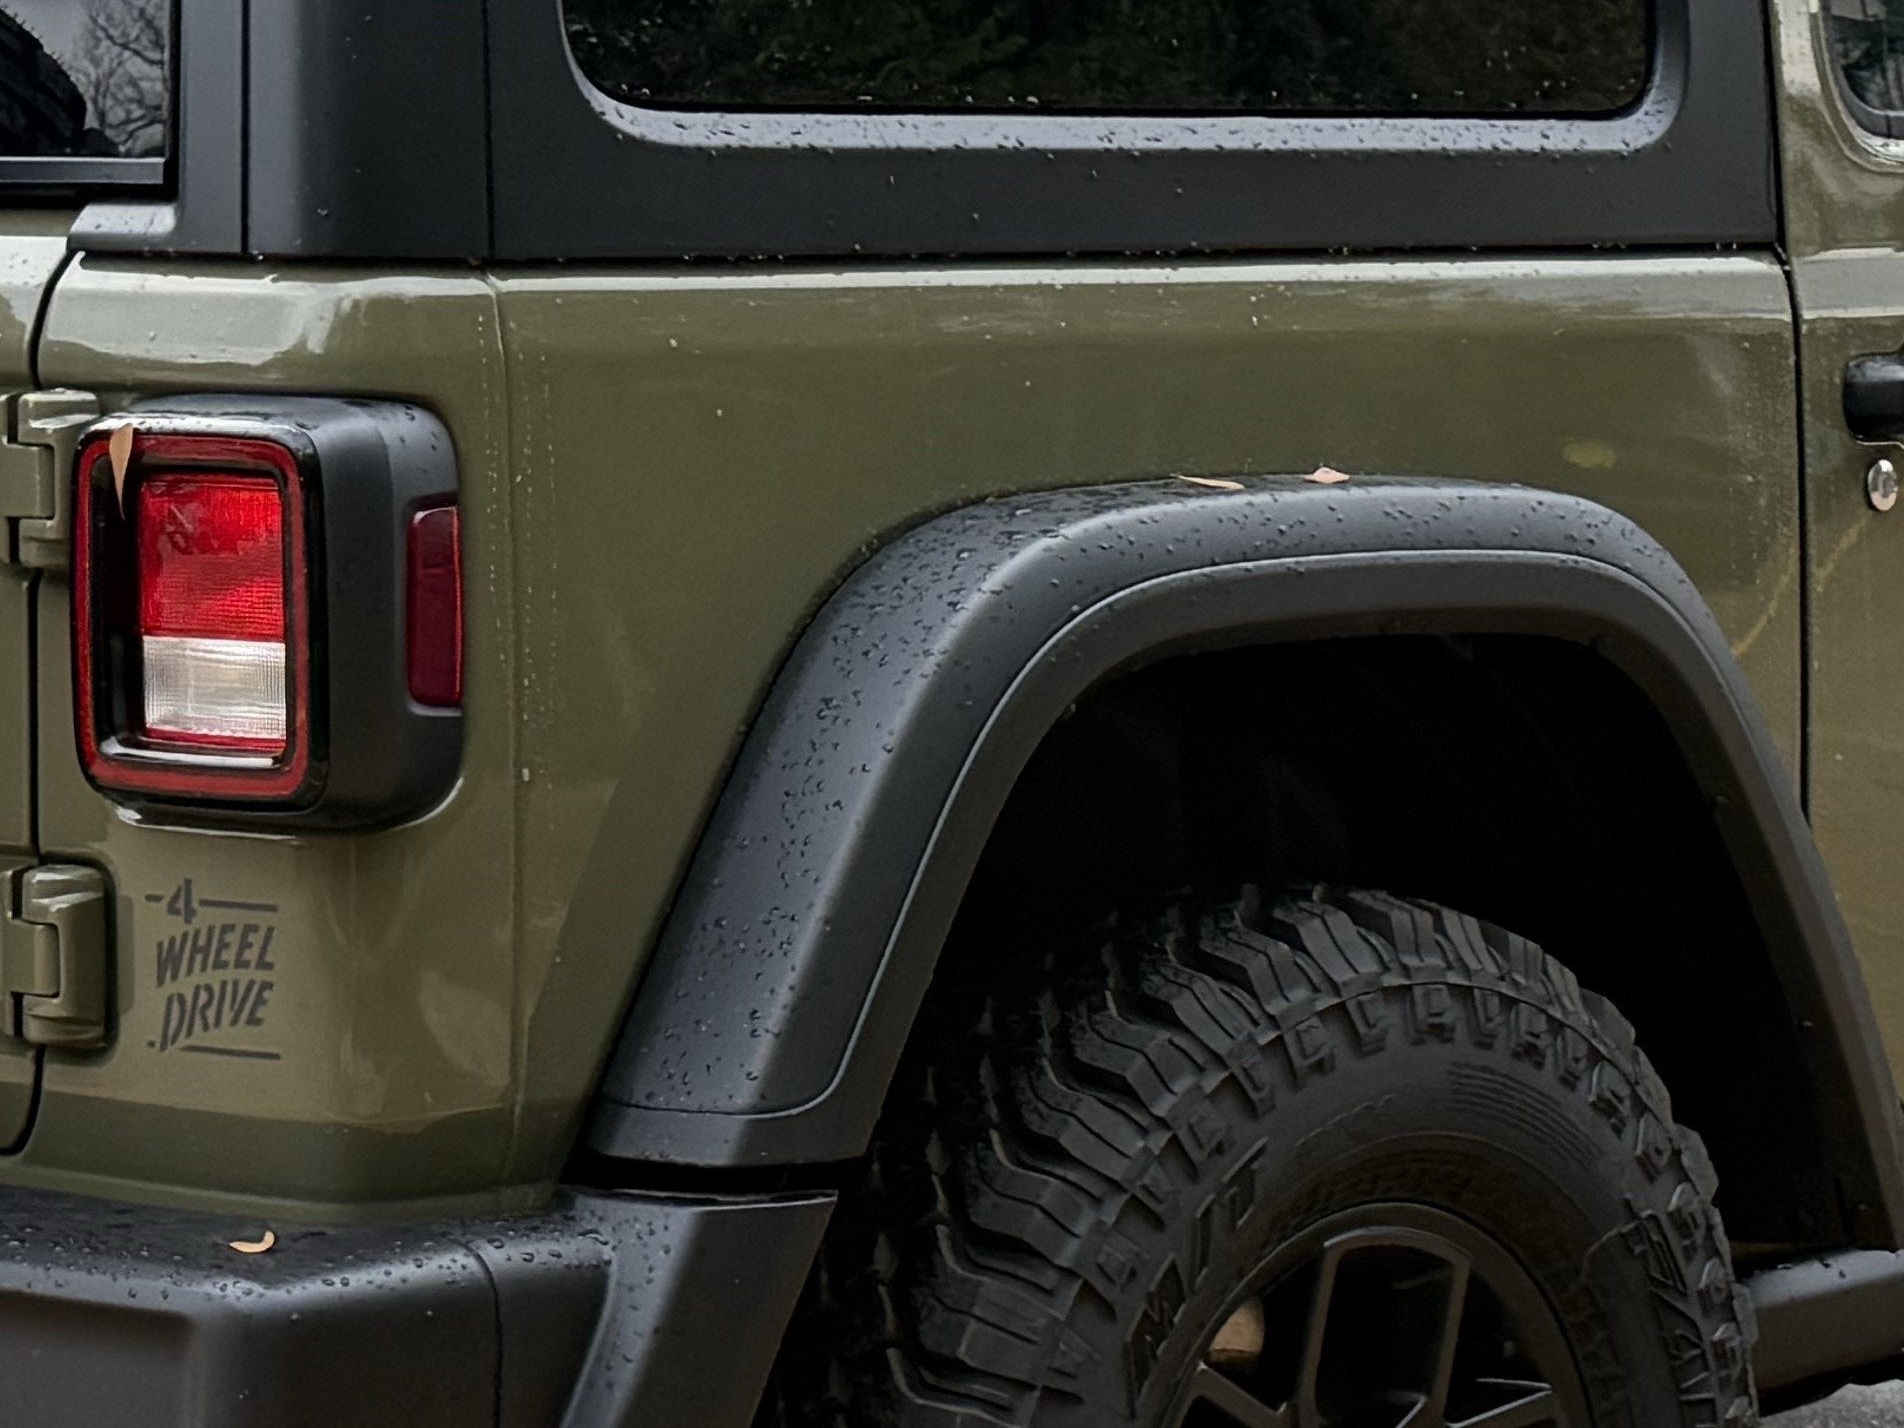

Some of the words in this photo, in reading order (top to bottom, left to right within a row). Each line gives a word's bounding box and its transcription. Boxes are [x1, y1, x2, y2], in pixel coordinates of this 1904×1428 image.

[167, 877, 197, 925] 4
[156, 923, 276, 989] WHEEL
[159, 979, 275, 1053] DRIVE
